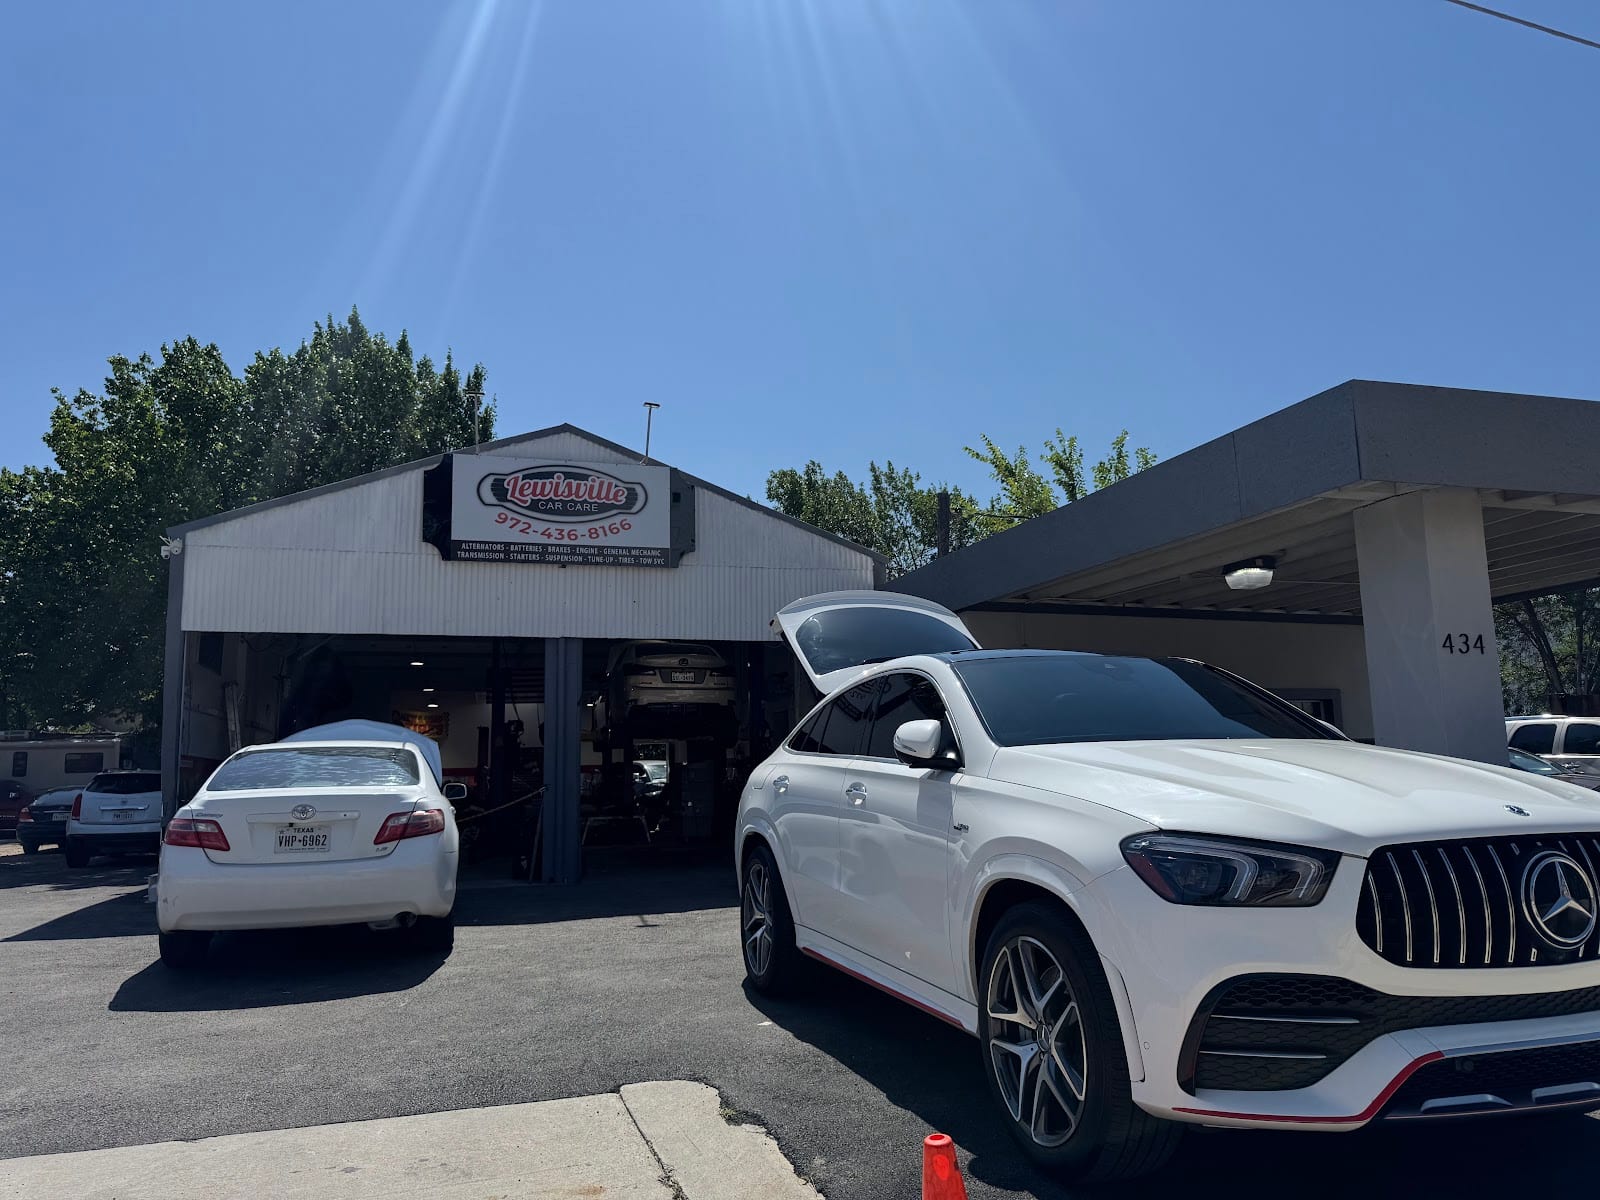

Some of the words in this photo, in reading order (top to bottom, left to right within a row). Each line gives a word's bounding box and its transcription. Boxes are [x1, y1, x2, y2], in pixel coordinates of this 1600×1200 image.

[505, 473, 627, 505] Lewisville
[538, 501, 562, 510] CAR
[567, 503, 599, 512] CARE
[494, 512, 632, 541] 972-436-8166
[457, 551, 505, 559] TRANSMISSION
[510, 553, 540, 561] STARTERS
[545, 554, 583, 562] SUSPENSION
[461, 543, 505, 551] ALTERNATORS
[510, 544, 542, 552] BATTERIES
[603, 548, 630, 556] GENERAL
[631, 549, 661, 557] MECHANIC
[1442, 633, 1486, 655] 434
